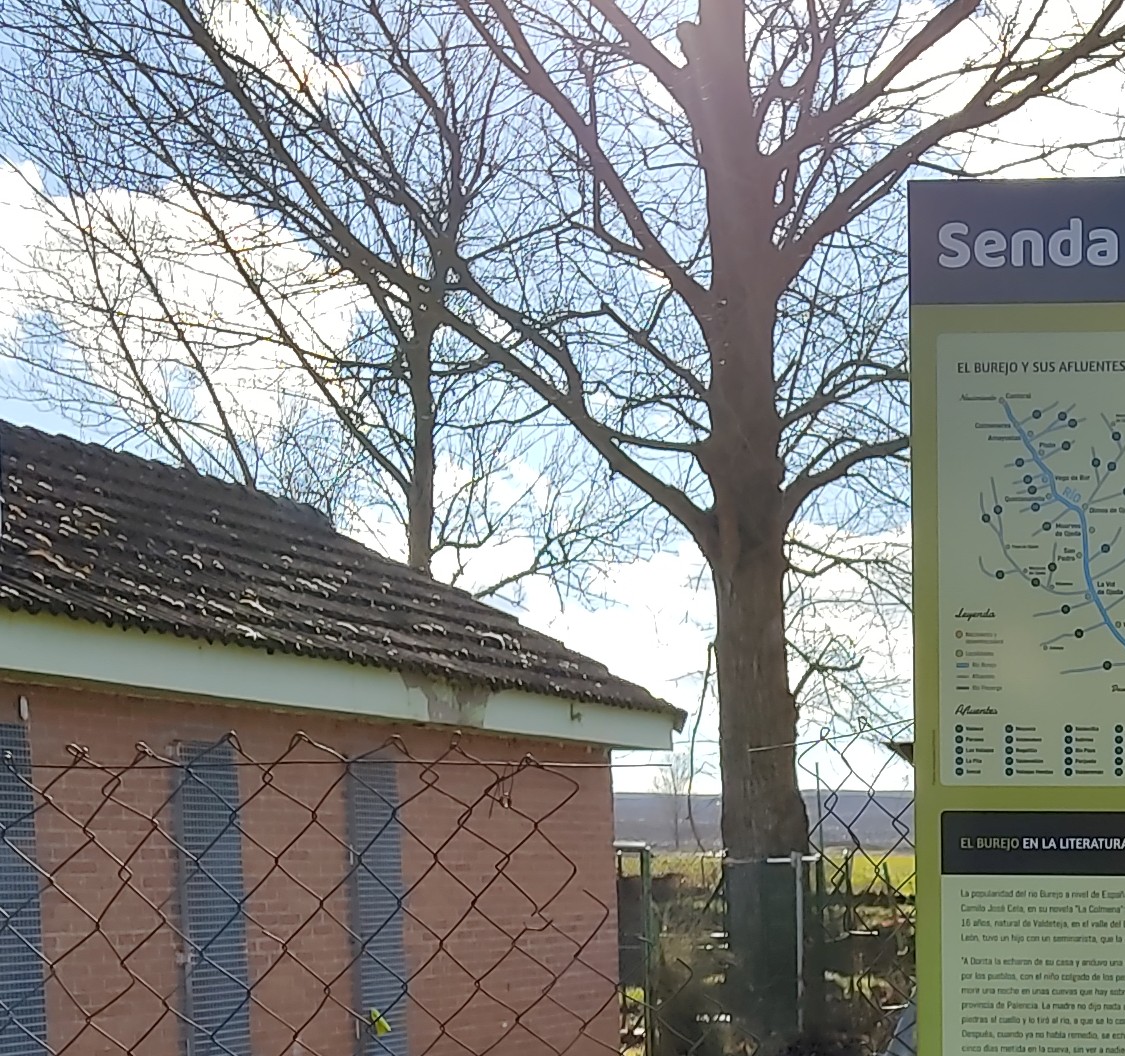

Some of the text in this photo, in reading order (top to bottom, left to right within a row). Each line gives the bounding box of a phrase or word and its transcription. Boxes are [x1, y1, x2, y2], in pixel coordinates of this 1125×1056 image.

[938, 217, 1120, 270] Senda
[957, 360, 1125, 376] EL BUREJO Y SUS AFLUENTES
[960, 838, 974, 849] EL
[976, 838, 1020, 851] BUREJO
[1022, 838, 1039, 849] EN
[1041, 838, 1057, 850] LA
